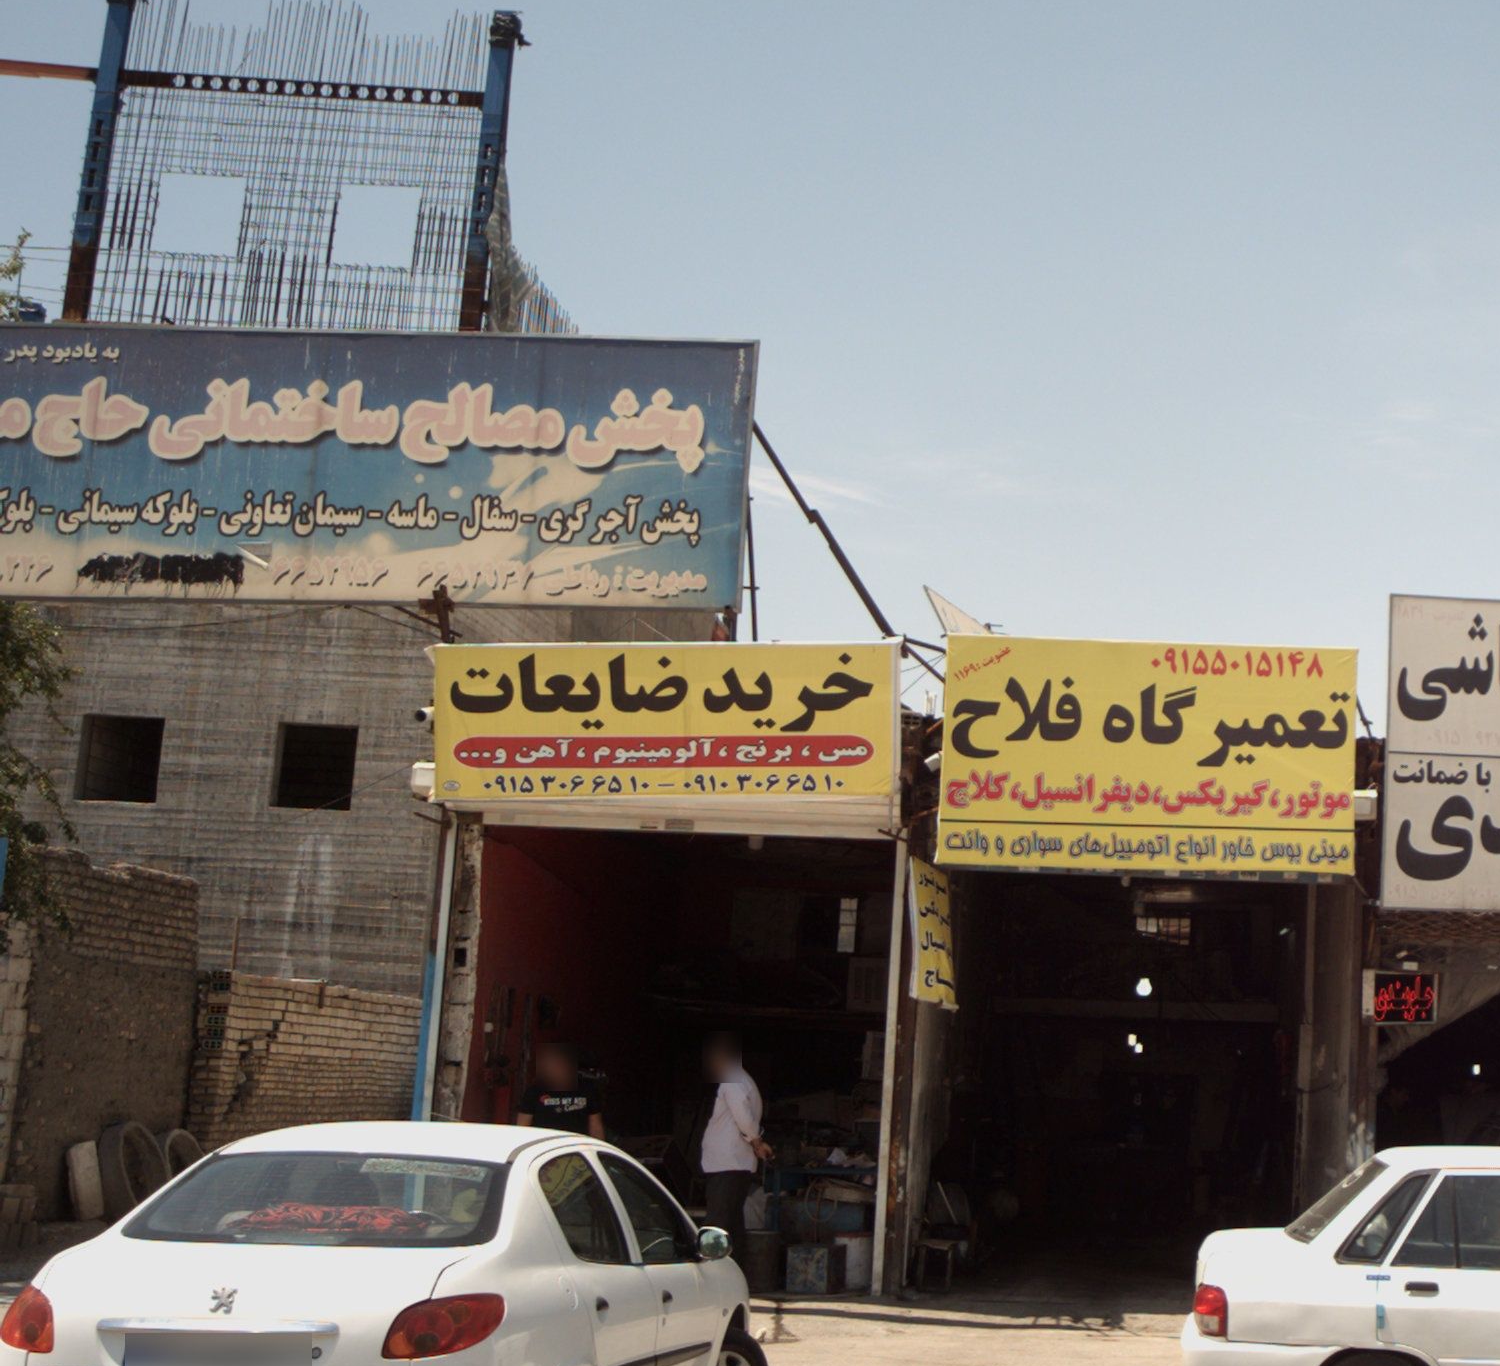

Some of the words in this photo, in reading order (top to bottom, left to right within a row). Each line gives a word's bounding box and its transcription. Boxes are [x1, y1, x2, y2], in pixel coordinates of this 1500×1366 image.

[3, 343, 38, 364] پدر
[41, 340, 98, 364] یادبود
[101, 344, 120, 364] به
[33, 376, 149, 457] حاج
[148, 376, 399, 460] ساختمانی
[400, 382, 563, 463] مصالح
[568, 388, 705, 473] پخش
[56, 490, 139, 536] سیمانی
[140, 490, 199, 536] بلوکه
[218, 491, 294, 536] تعاونی
[292, 493, 364, 538] سیمان
[386, 497, 440, 533] ماسه
[460, 497, 519, 541] سفال
[594, 496, 640, 544] آجر
[641, 504, 702, 548] پخش
[1151, 647, 1324, 679] ۰۹۱۵۵۰۱۵۱۴۸
[450, 652, 689, 730] ضایعات
[703, 652, 875, 732] خرید
[951, 676, 1084, 759] فلاح
[1102, 683, 1198, 745] گاه
[1196, 691, 1351, 767] تعمیر
[514, 738, 573, 765] آهن
[1393, 760, 1469, 787] ضمانت
[945, 769, 1009, 808] کلاچ
[1476, 762, 1492, 787] با
[945, 829, 989, 856] وانت
[994, 839, 1005, 857] و
[1009, 831, 1063, 857] سواری
[1175, 833, 1216, 864] انواع
[1260, 843, 1301, 864] بوس
[1308, 838, 1350, 865] مینی
